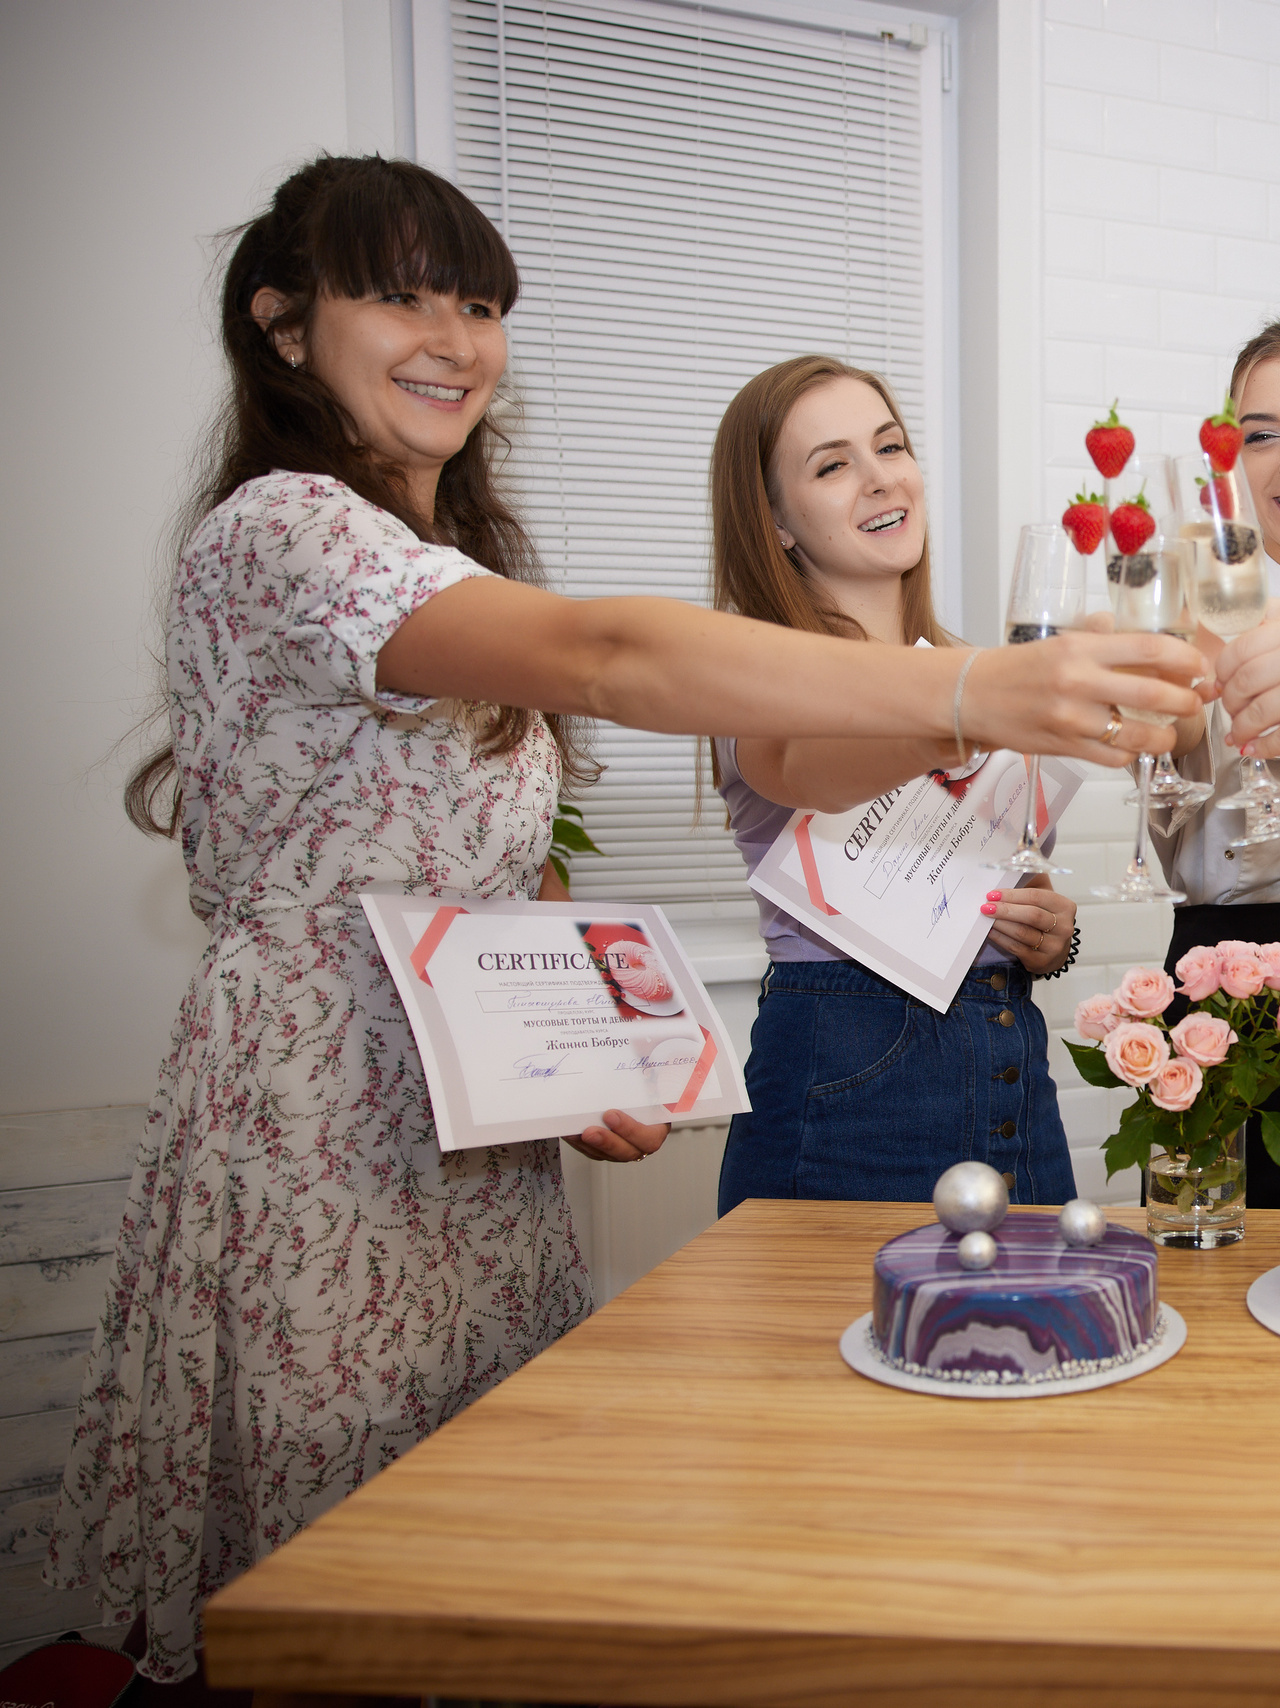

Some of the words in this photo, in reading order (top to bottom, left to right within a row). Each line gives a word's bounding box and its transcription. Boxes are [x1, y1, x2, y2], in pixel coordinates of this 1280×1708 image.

[904, 845, 932, 882] МУССОВЫЕ
[929, 819, 948, 845] ТОРТЫ
[950, 789, 968, 815] ДЕКОР
[927, 848, 953, 885] Жанна
[950, 814, 977, 849] Бобрус
[478, 952, 630, 971] CERTIFICATE
[523, 1019, 570, 1028] МУССОВЫЕ
[571, 1017, 600, 1026] ТОРТЫ
[609, 1015, 634, 1024] ДЕКОР
[546, 1039, 589, 1050] Жанна
[591, 1037, 630, 1049] Бобрус
